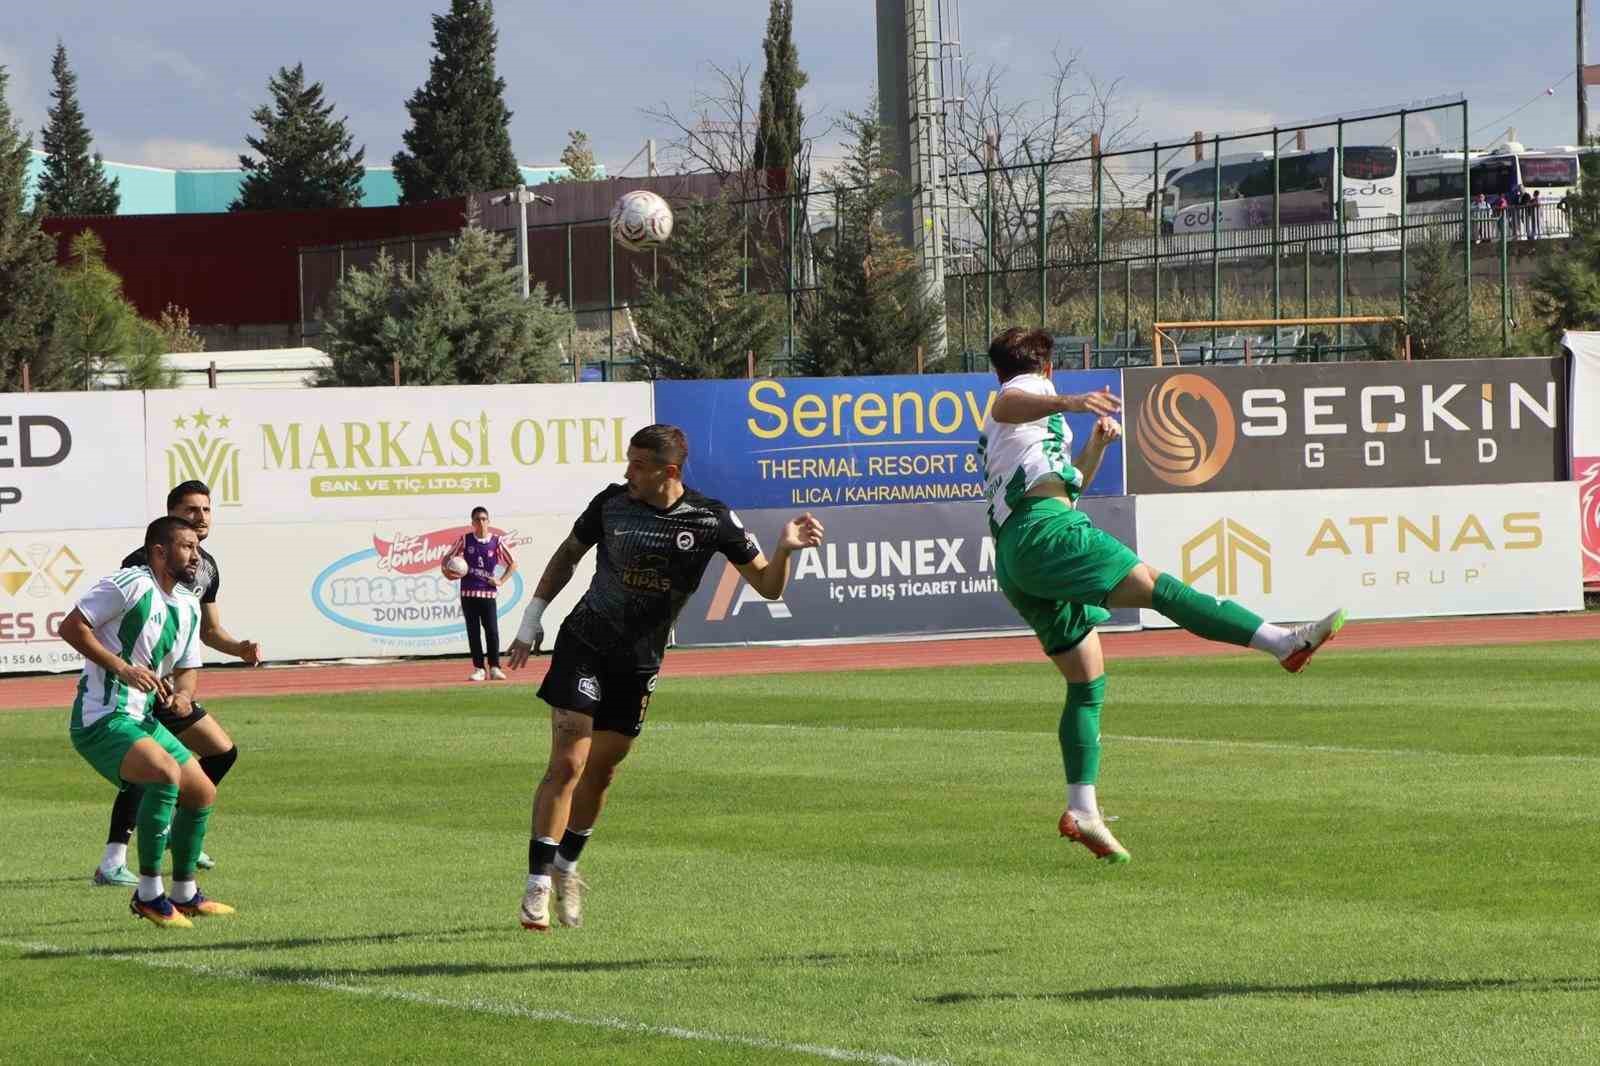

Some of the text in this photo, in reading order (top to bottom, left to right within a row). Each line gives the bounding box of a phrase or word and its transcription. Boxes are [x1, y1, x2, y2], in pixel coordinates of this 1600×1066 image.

[747, 380, 999, 439] Serenov
[510, 416, 629, 466] OTEL
[1304, 438, 1498, 468] GOLD
[758, 454, 979, 480] THERMAL RESORT &
[366, 479, 390, 490] VE
[792, 487, 833, 504] ILICA
[845, 483, 984, 502] KAHRAMANMARA
[1306, 511, 1544, 557] ATNAS
[794, 537, 967, 581] ALUNEX
[331, 576, 459, 605] maras
[829, 582, 844, 603] İÇ
[849, 585, 867, 599] VE
[901, 578, 958, 597] TİCARET
[961, 575, 1002, 593] LİMİT
[1361, 568, 1480, 586] GRUP
[29, 654, 42, 663] 66
